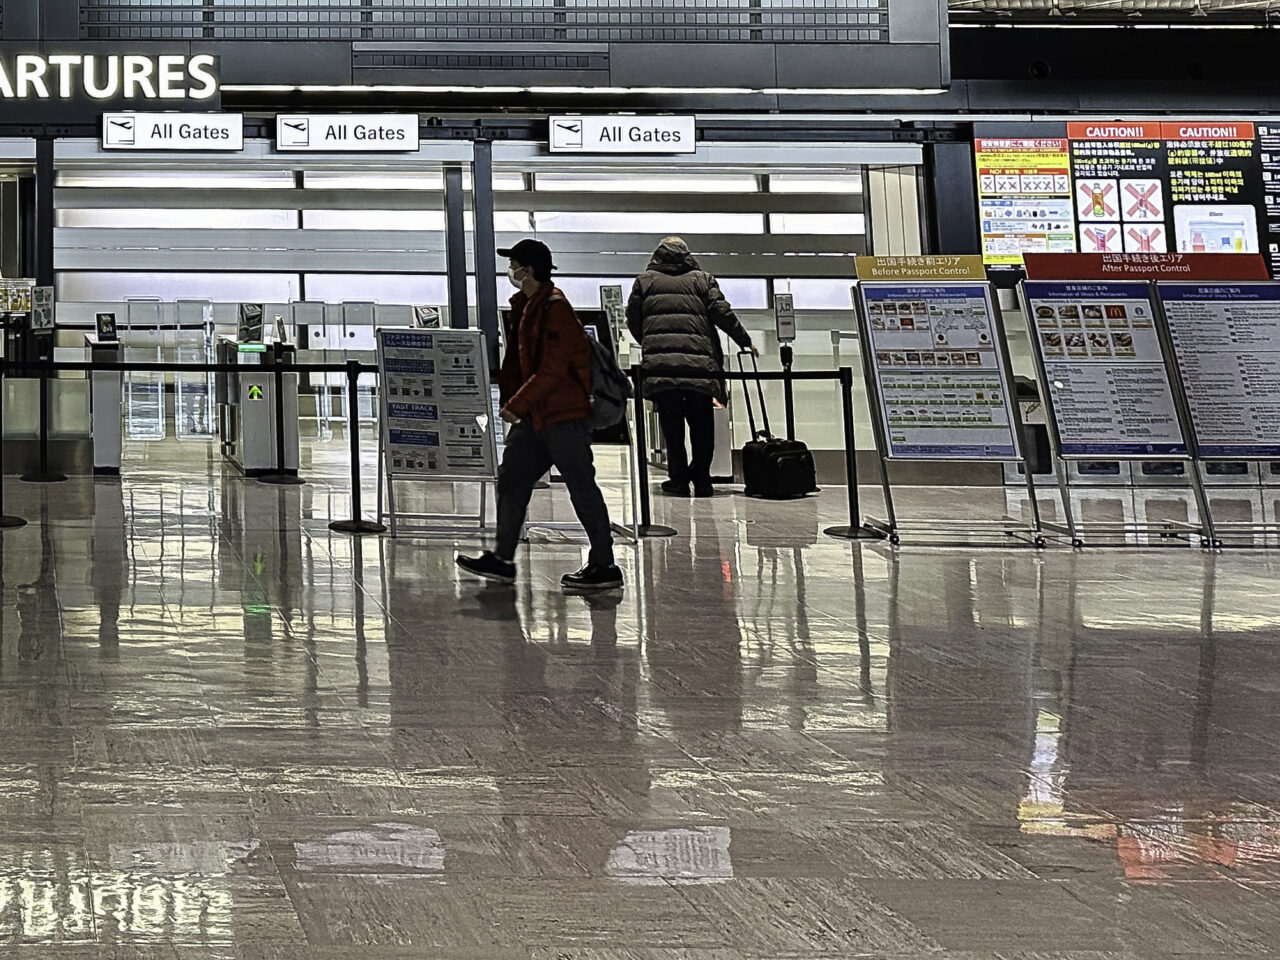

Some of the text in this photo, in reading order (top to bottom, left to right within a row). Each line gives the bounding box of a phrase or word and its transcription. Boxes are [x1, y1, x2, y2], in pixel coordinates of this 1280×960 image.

[150, 123, 229, 141] All Gates
[325, 123, 404, 142] All Gates
[599, 125, 681, 144] All Gates
[1086, 128, 1143, 137] CAUTION!!
[1180, 128, 1236, 137] CAUTION!!
[902, 268, 937, 276] Passport
[1102, 264, 1190, 274] After Passport Control
